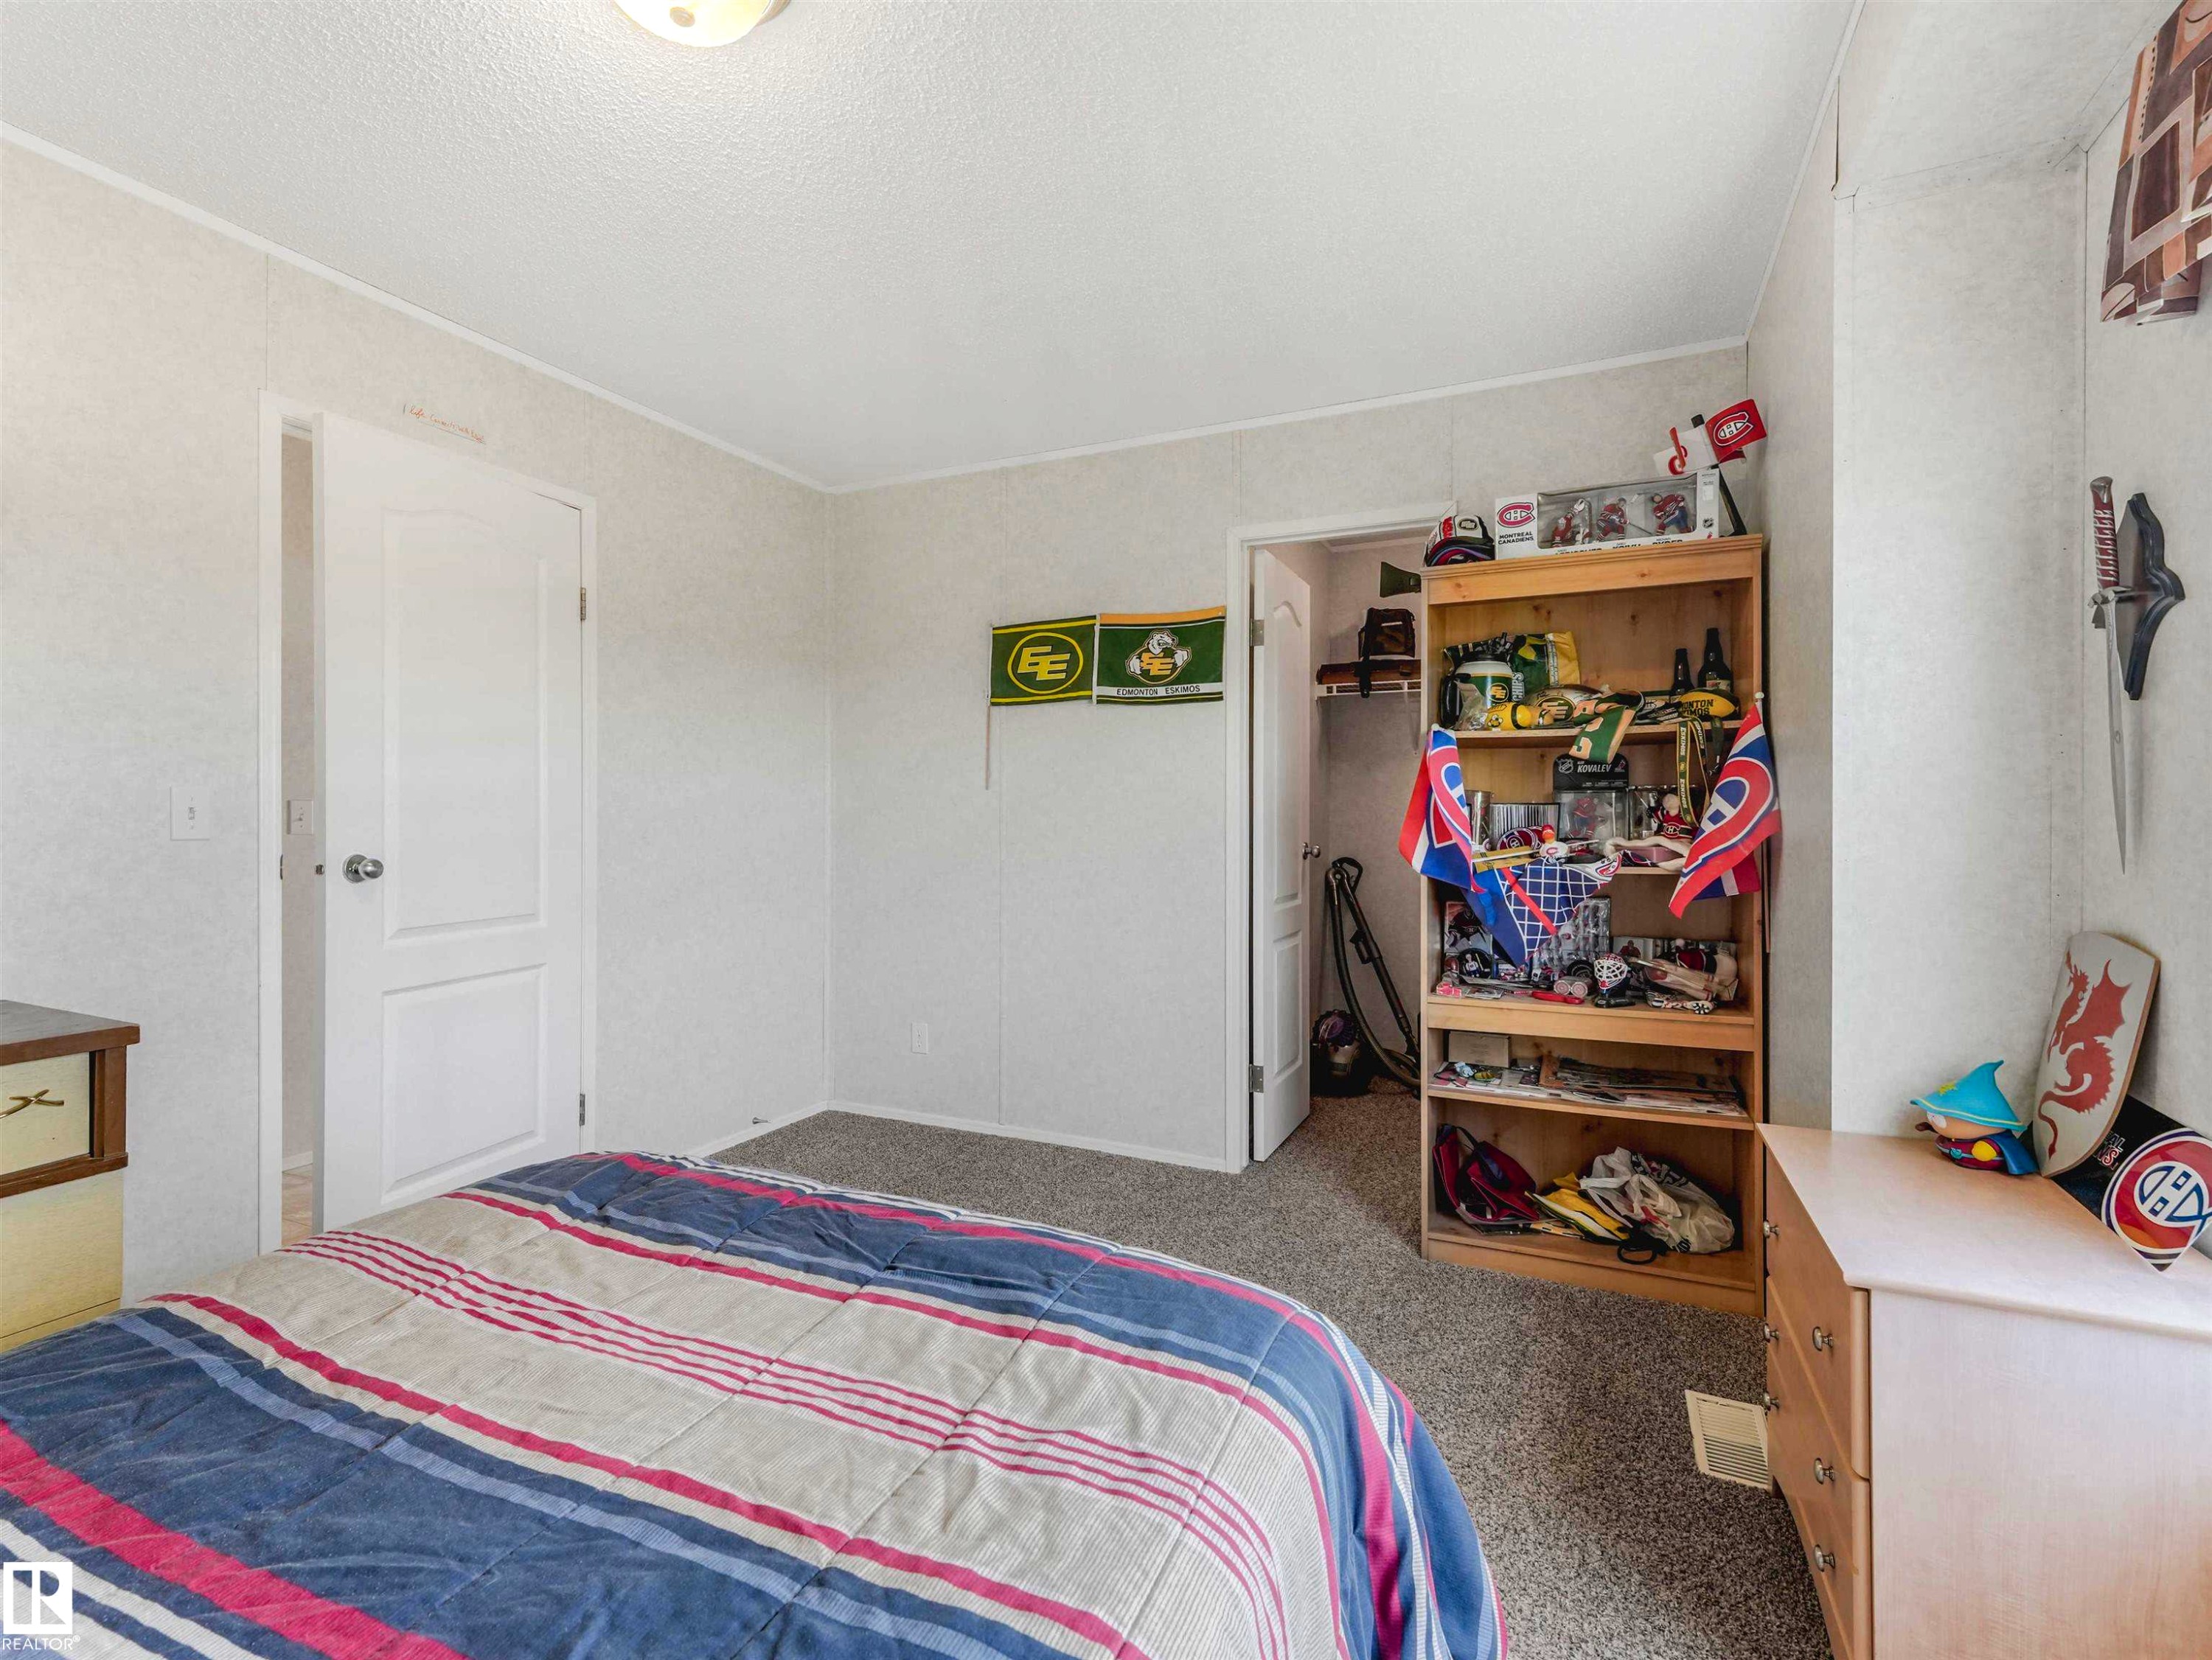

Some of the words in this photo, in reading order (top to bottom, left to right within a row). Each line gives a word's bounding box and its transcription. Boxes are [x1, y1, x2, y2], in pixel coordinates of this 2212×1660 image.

[1498, 536, 1534, 545] CANADIENS
[1499, 531, 1533, 540] MONTREAL
[1018, 645, 1071, 681] EE
[1116, 688, 1158, 696] EDMONTON
[1165, 685, 1201, 694] ESKIMOS
[1512, 672, 1525, 702] CHIPS
[1576, 764, 1613, 773] KOVALEV
[1680, 778, 1688, 809] ESKIMOS
